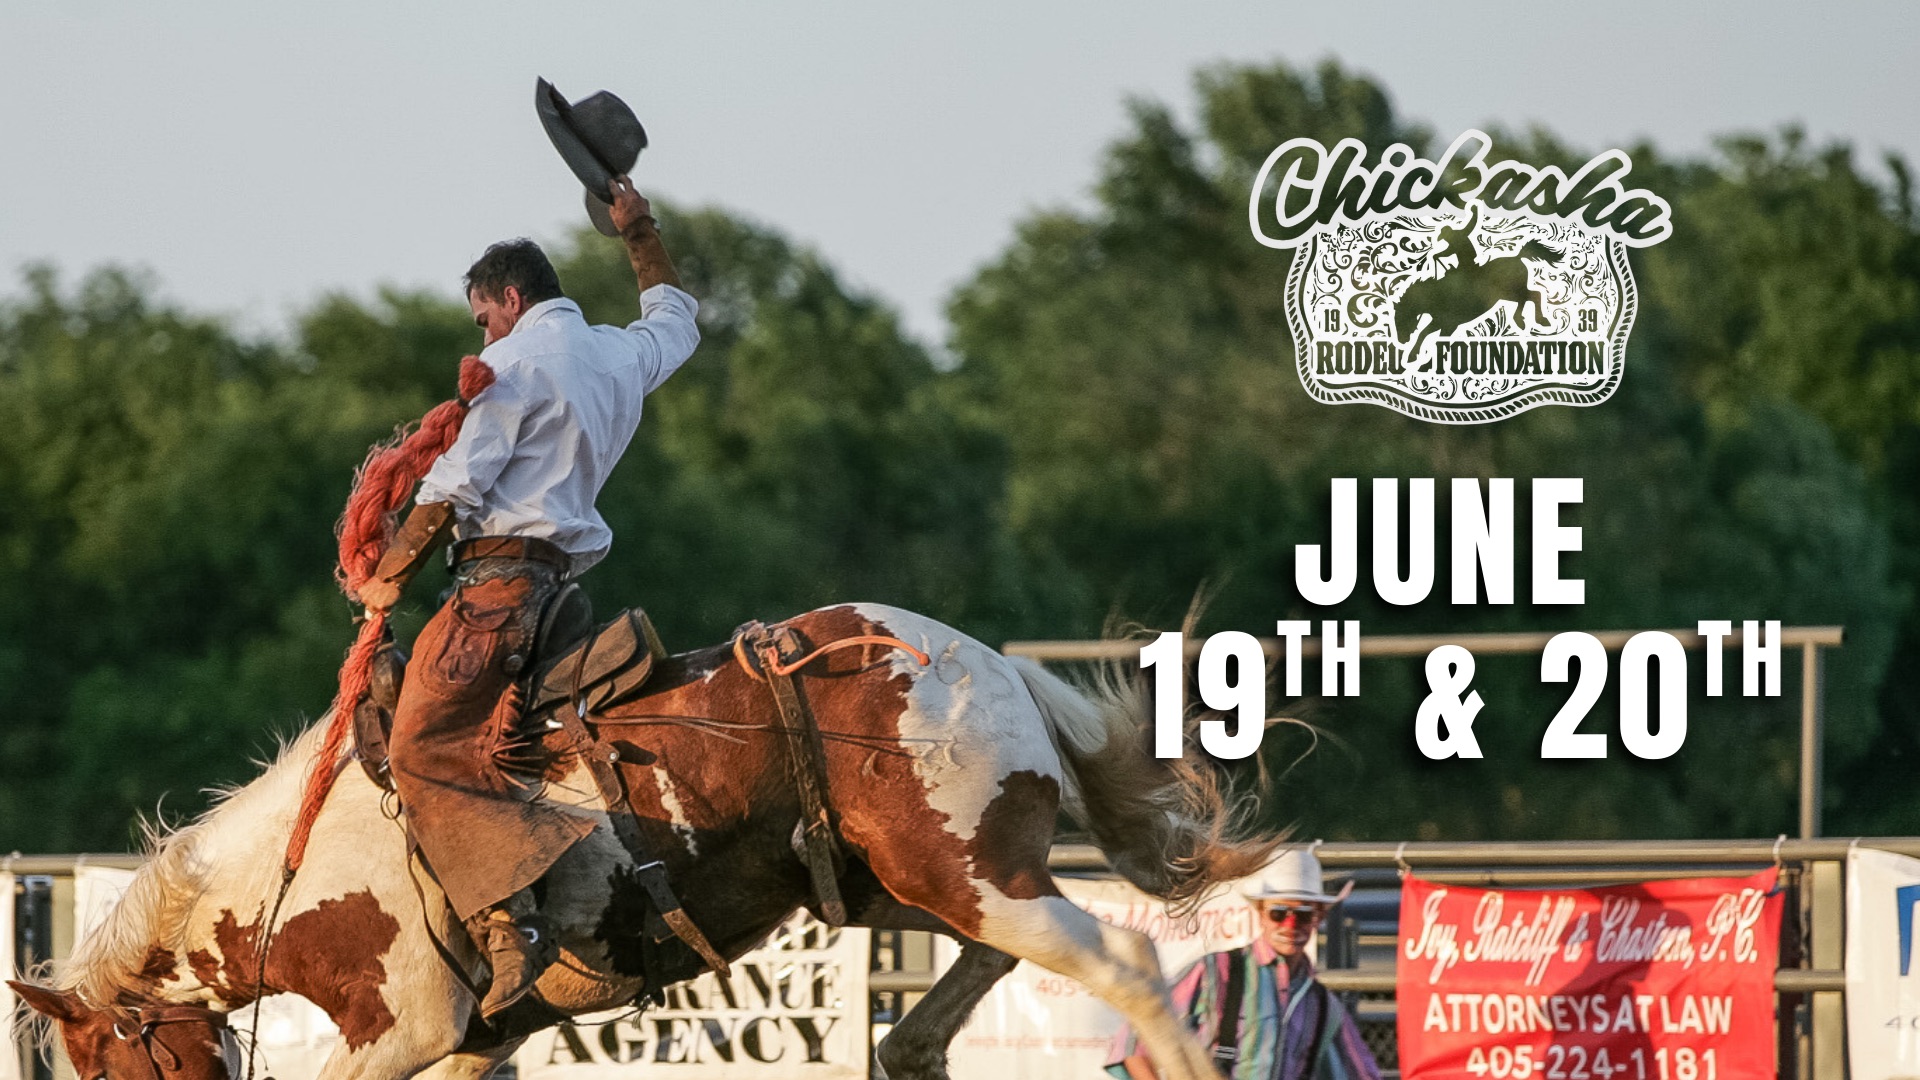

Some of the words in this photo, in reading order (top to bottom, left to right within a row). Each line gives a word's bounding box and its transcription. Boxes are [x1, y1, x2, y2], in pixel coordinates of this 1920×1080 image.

[1464, 891, 1576, 986] Ratcliff
[1564, 911, 1589, 962] &
[664, 961, 840, 1010] RANCE
[1423, 993, 1610, 1034] ATTORNEYS
[1612, 995, 1654, 1033] AT
[1660, 995, 1734, 1034] LAW
[548, 1017, 841, 1064] AGENCY
[1466, 1045, 1718, 1080] 405-224-1181
